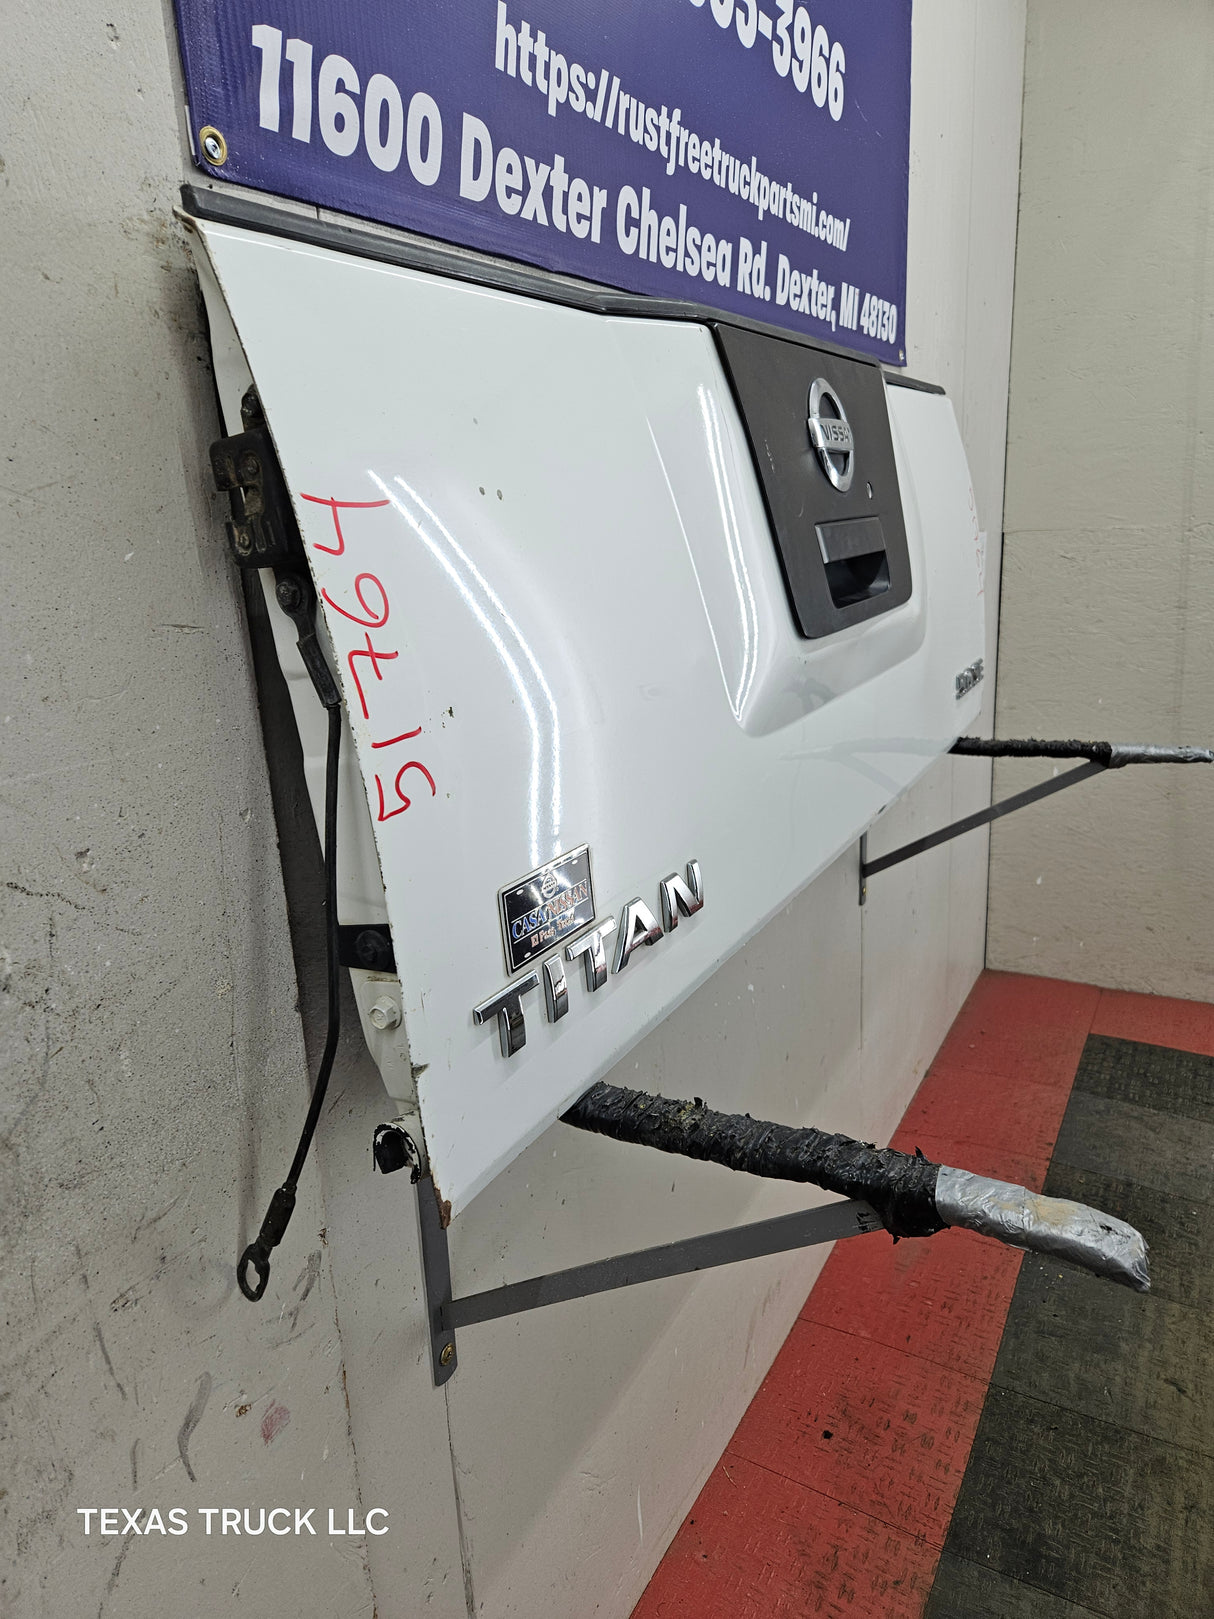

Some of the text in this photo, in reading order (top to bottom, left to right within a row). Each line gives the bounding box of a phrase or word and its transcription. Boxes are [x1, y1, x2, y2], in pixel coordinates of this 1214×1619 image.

[252, 24, 443, 187] 11600
[459, 111, 607, 245] Dexter
[617, 185, 732, 287] Chelsea
[737, 237, 771, 302] Rd.
[776, 253, 836, 332] Dexter,
[860, 293, 897, 345] 48130
[494, 0, 851, 252] https://rustfreetruckpartsmi.com/
[300, 492, 436, 822] 51764
[473, 859, 704, 1058] TITAN
[511, 908, 548, 940] CASA
[544, 881, 589, 918] NISSAN
